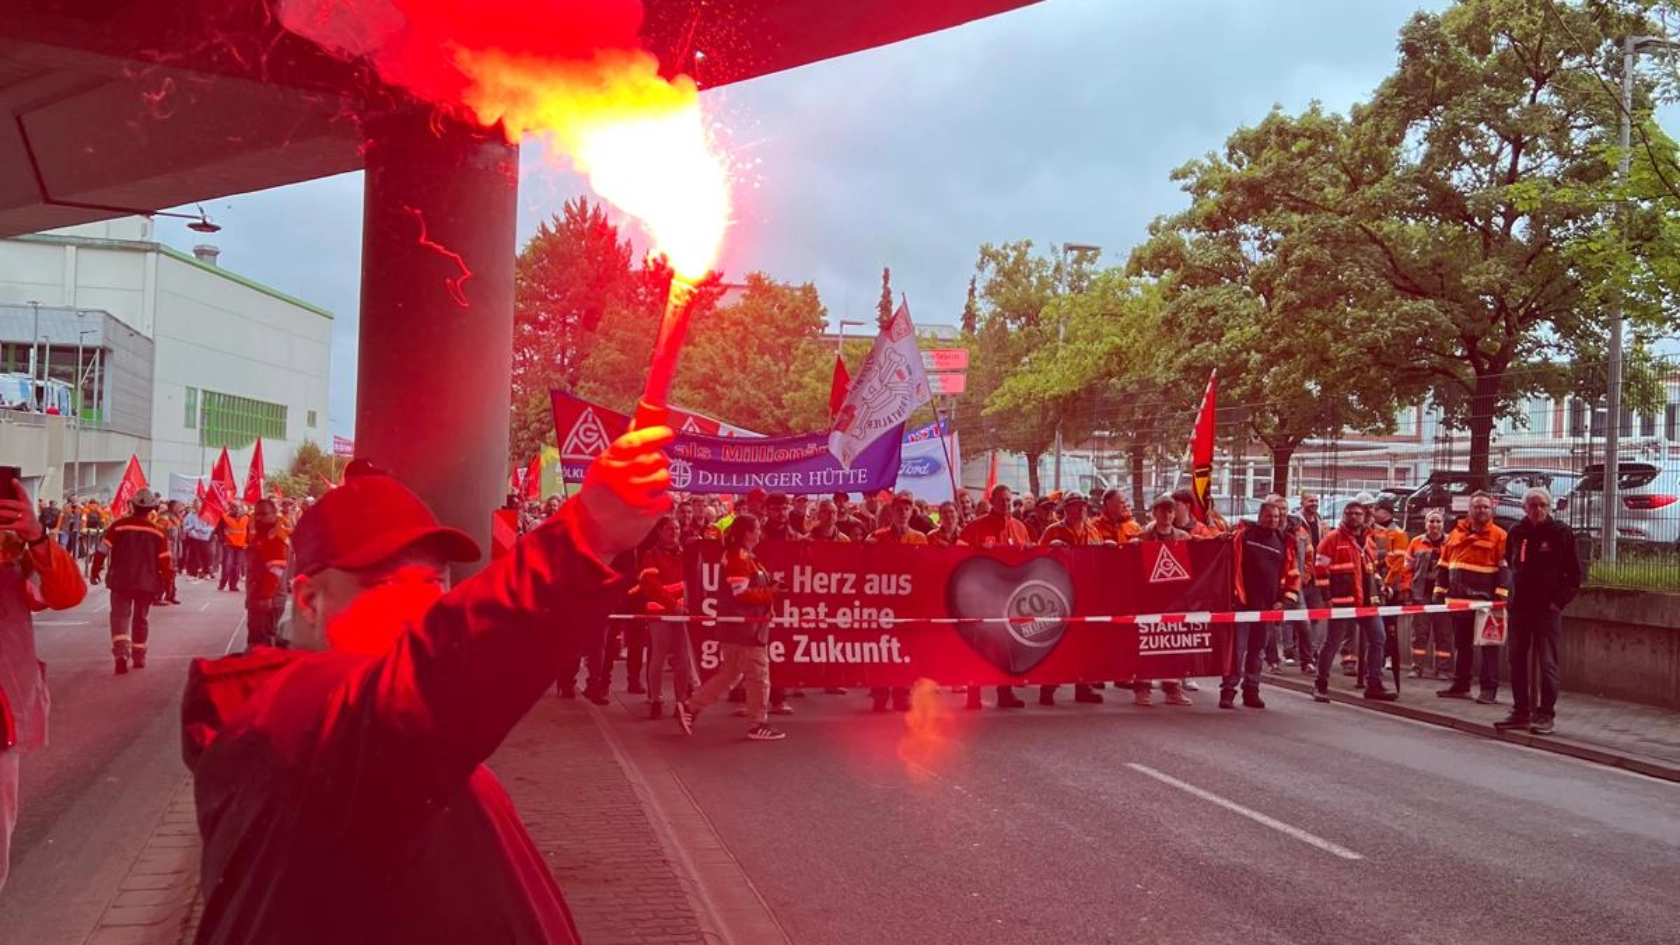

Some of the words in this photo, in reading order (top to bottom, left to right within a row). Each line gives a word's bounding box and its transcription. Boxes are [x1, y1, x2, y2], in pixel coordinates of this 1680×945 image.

[698, 469, 803, 487] DILLINGER
[808, 467, 868, 486] HÜTTE
[793, 565, 857, 594] Herz
[864, 571, 913, 595] aus
[783, 599, 829, 629] hat
[836, 599, 896, 629] eine
[1139, 620, 1188, 633] STAHL
[1189, 620, 1209, 631] IST
[793, 634, 912, 663] Zukunft.
[1139, 632, 1212, 649] ZUKUNFT
